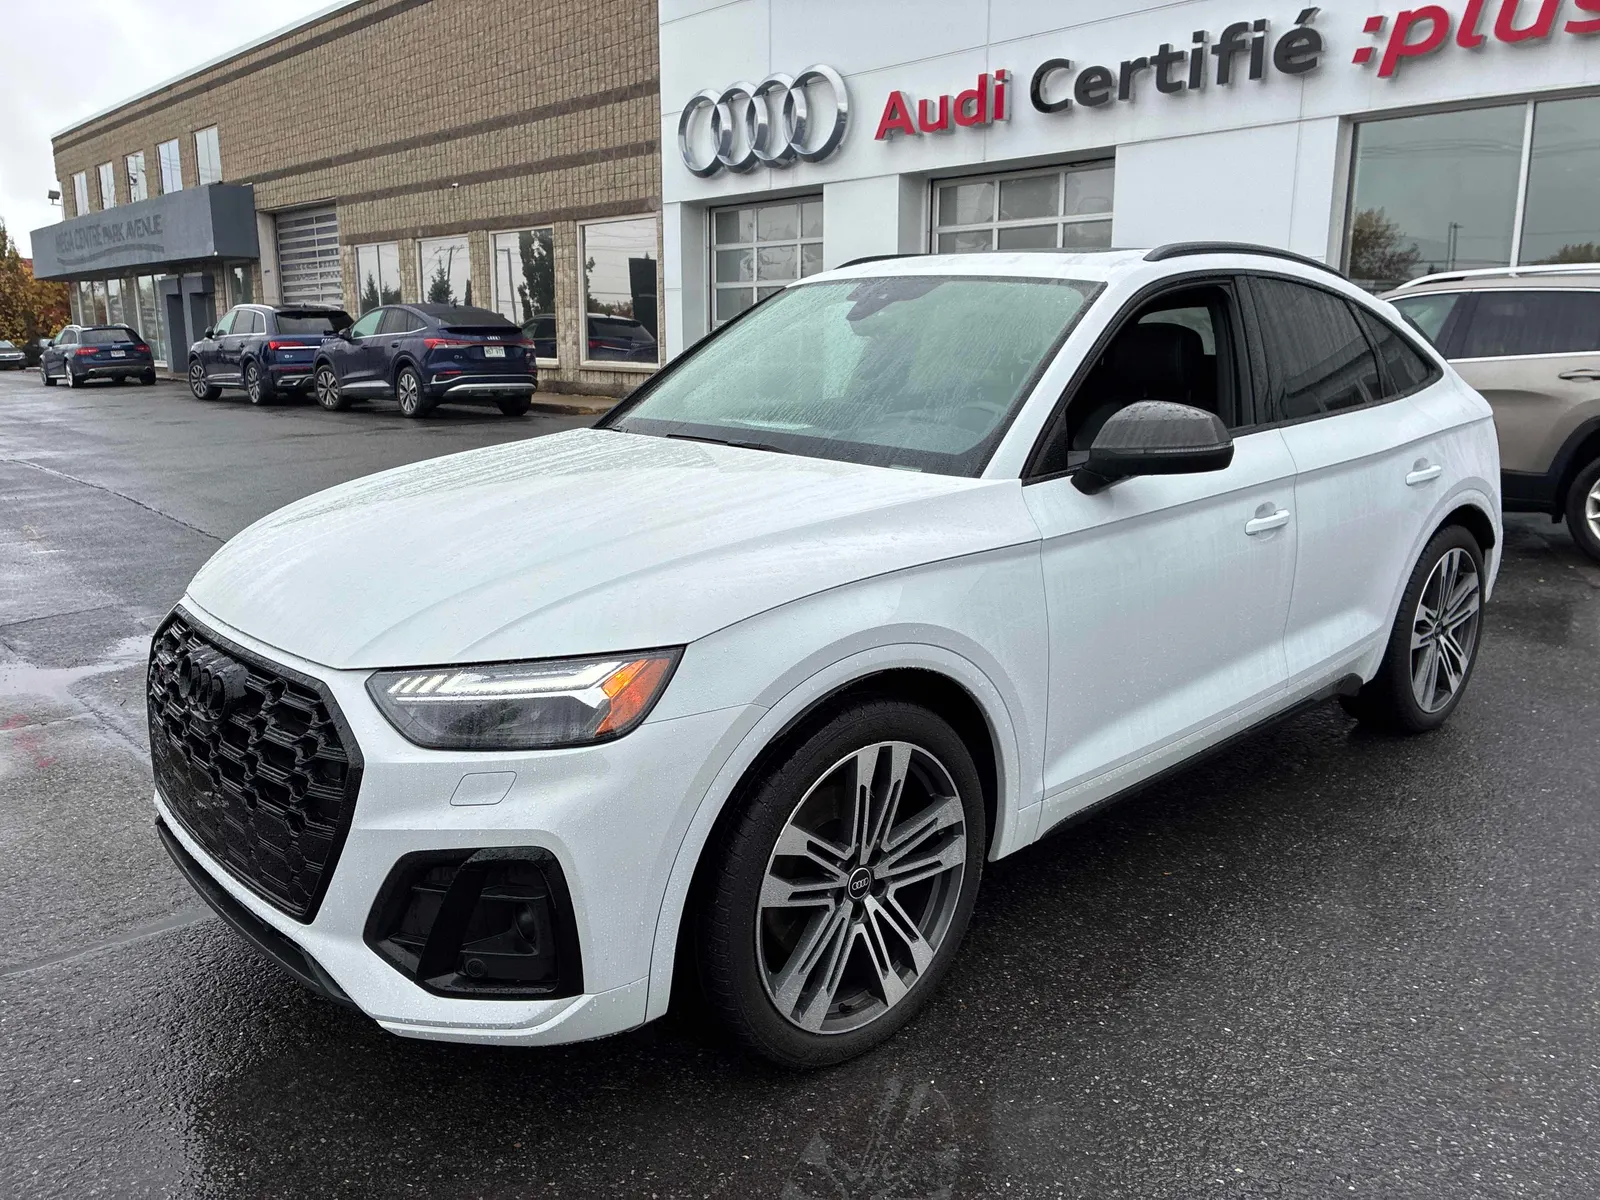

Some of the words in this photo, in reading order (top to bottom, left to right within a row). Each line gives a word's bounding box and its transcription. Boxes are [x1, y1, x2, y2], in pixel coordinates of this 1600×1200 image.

[874, 68, 1012, 141] Audi
[1030, 7, 1321, 114] Certifié
[74, 224, 102, 250] CENTRE
[102, 223, 125, 244] PARK
[126, 214, 163, 238] AVENUE
